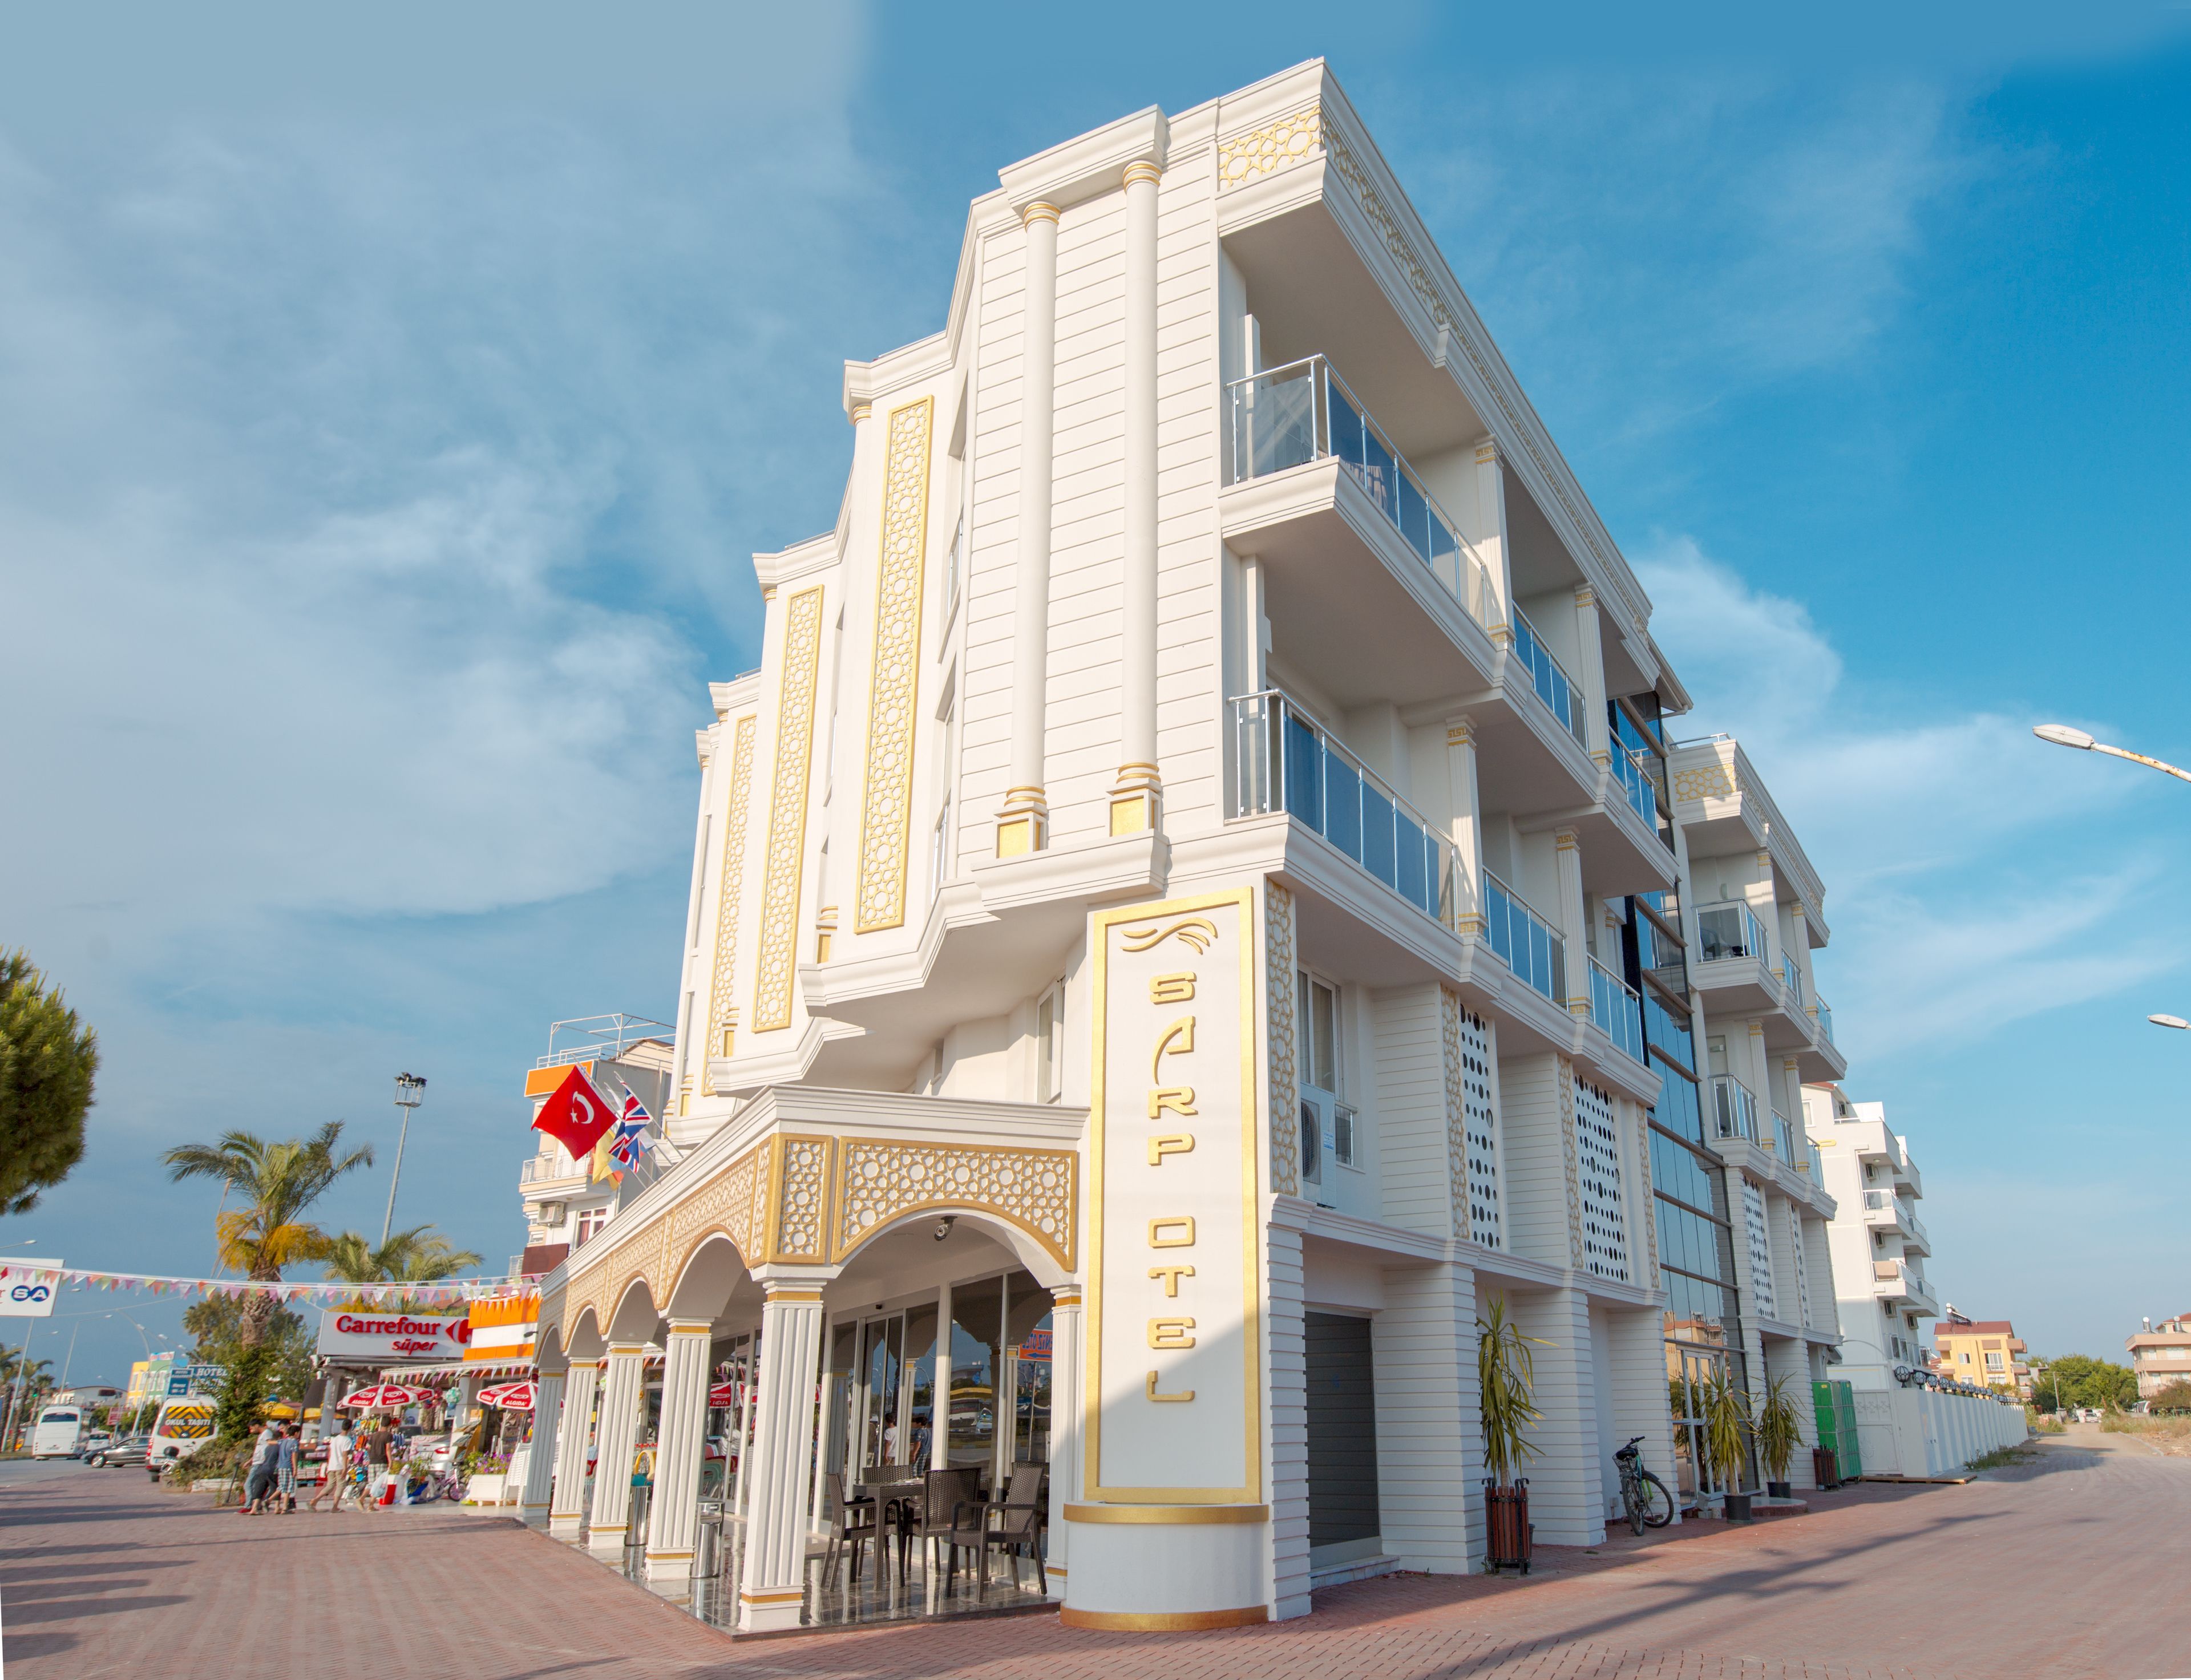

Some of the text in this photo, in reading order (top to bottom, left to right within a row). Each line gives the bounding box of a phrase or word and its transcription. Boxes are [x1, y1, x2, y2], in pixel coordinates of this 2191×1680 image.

[1146, 971, 1198, 1401] SARP OTEL
[13, 1288, 48, 1300] SA
[337, 1315, 440, 1335] Carrefour
[392, 1338, 438, 1356] süper
[196, 1367, 228, 1377] HOTEL
